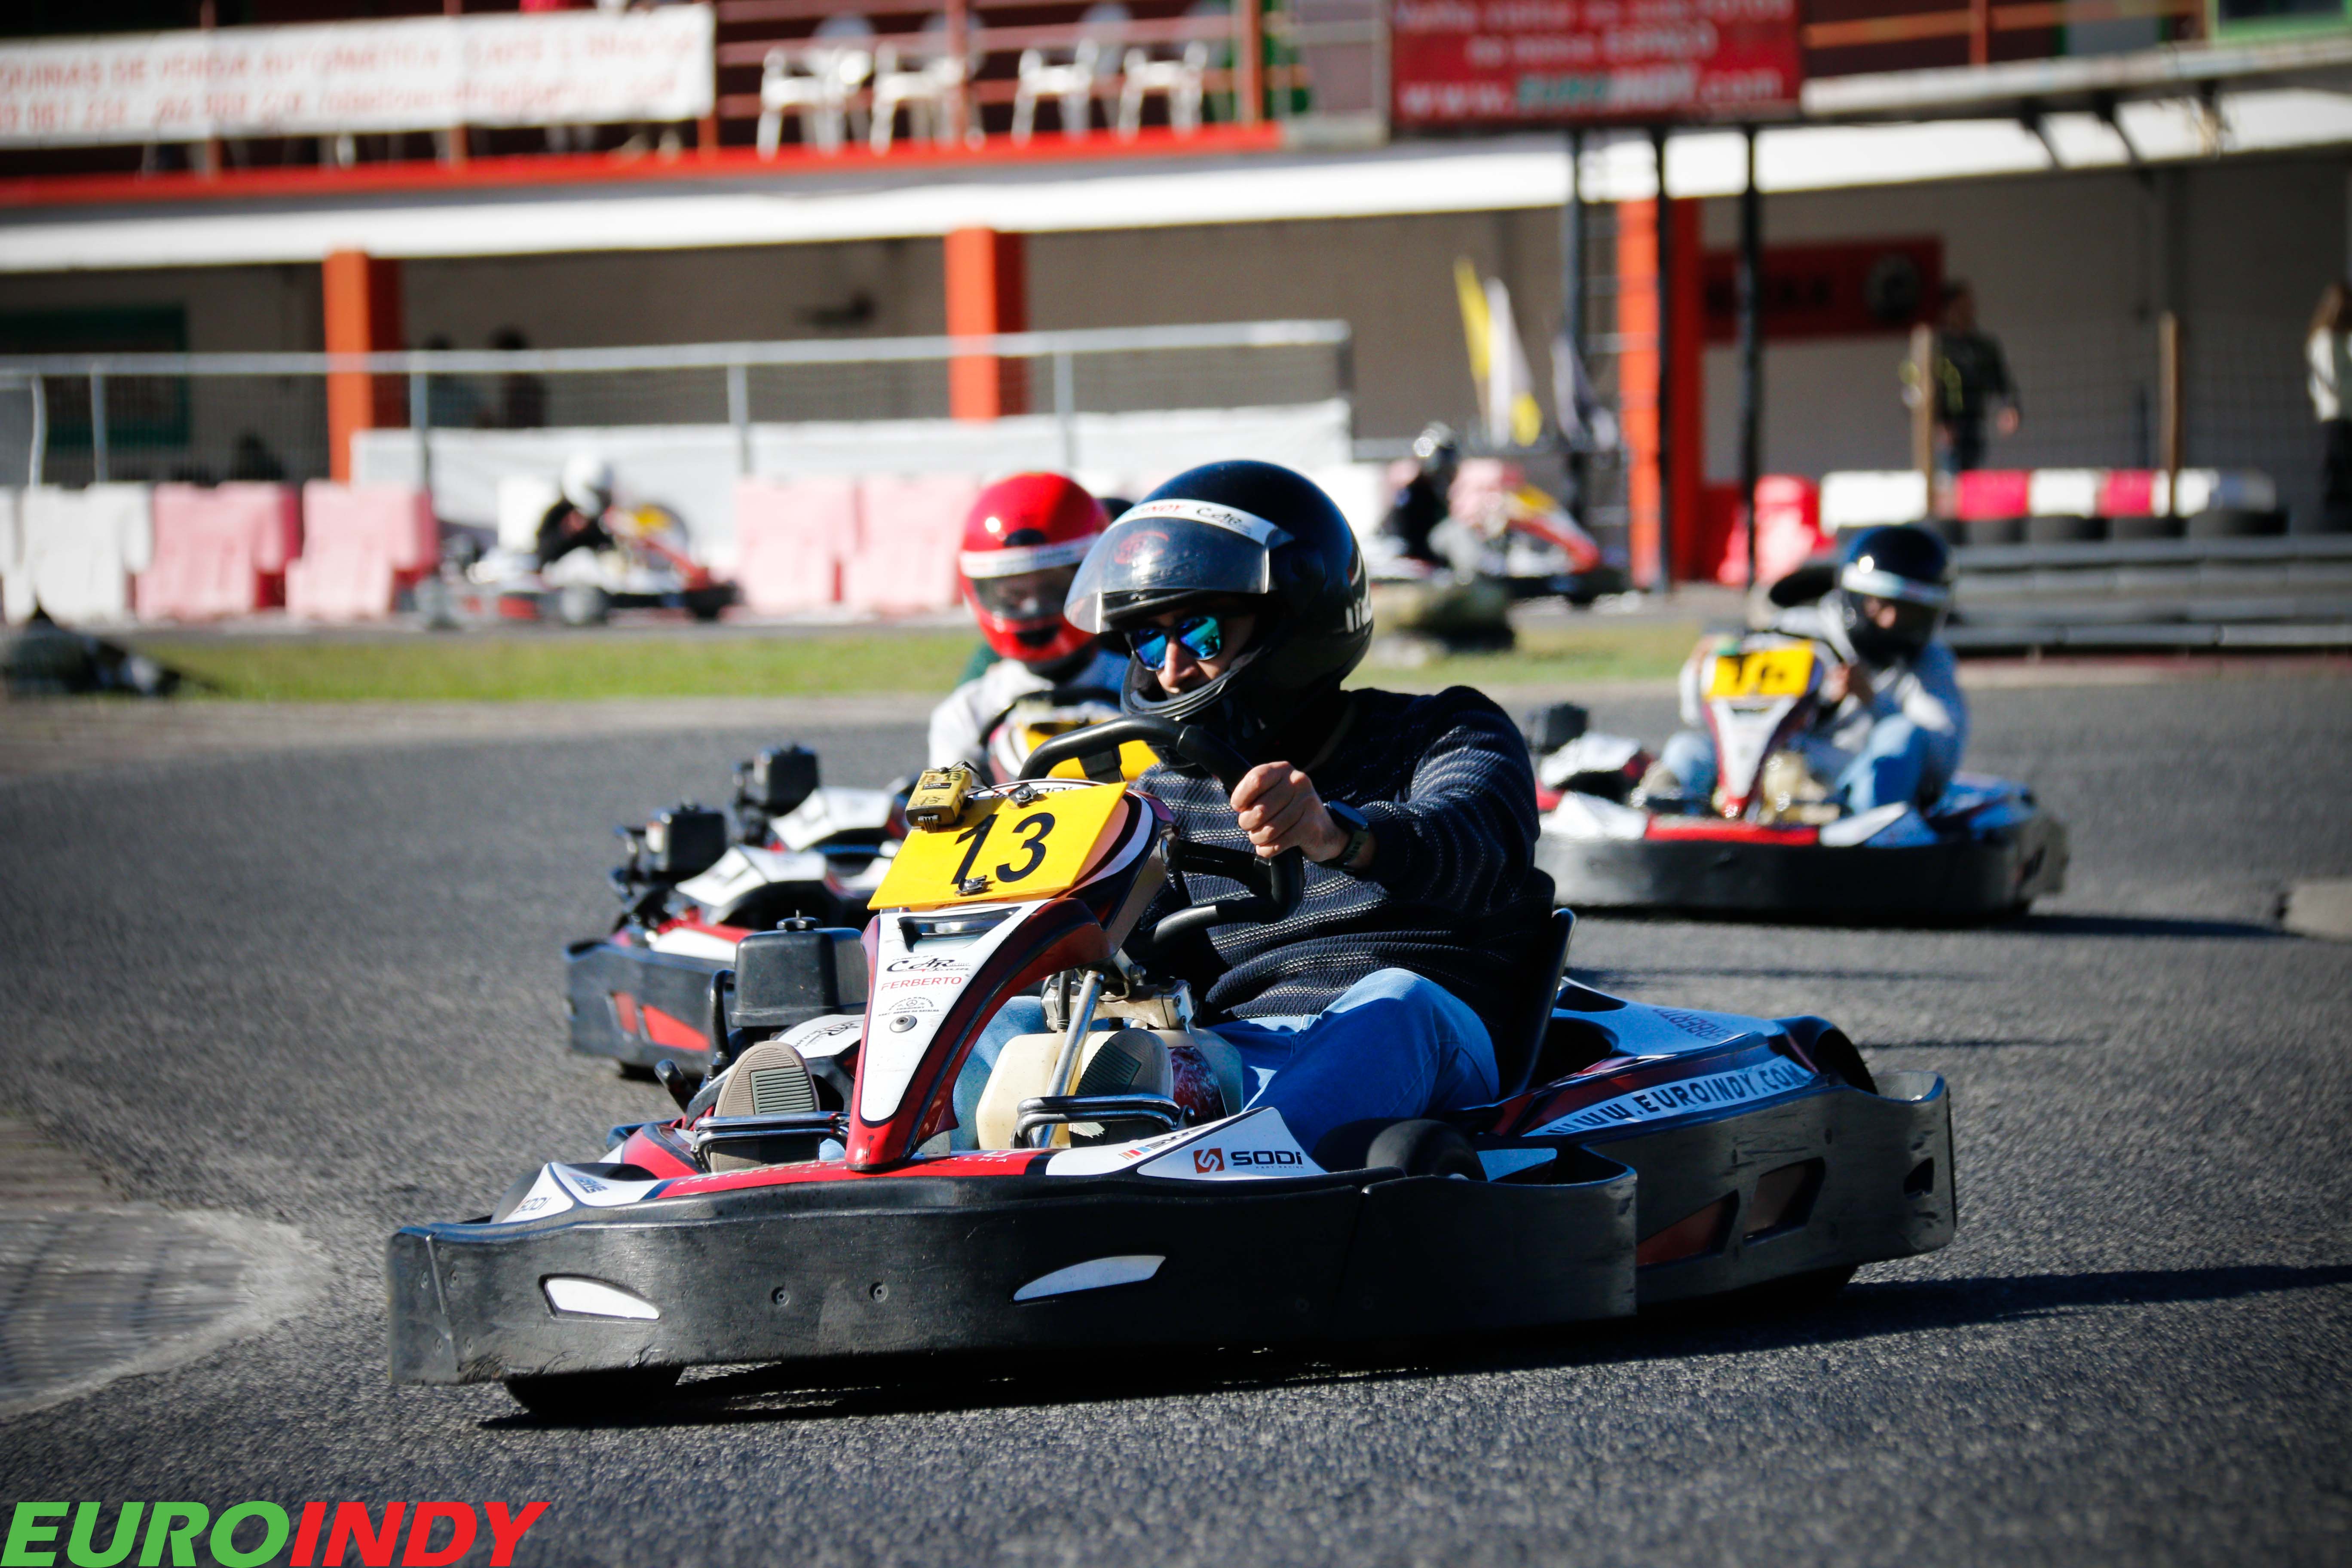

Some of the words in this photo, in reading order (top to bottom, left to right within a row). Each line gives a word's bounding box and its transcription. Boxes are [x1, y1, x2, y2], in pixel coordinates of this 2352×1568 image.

[950, 812, 1056, 885] 13
[881, 977, 962, 991] FERBERTO
[1546, 1062, 1809, 1135] WWW.EUROINDY.COM
